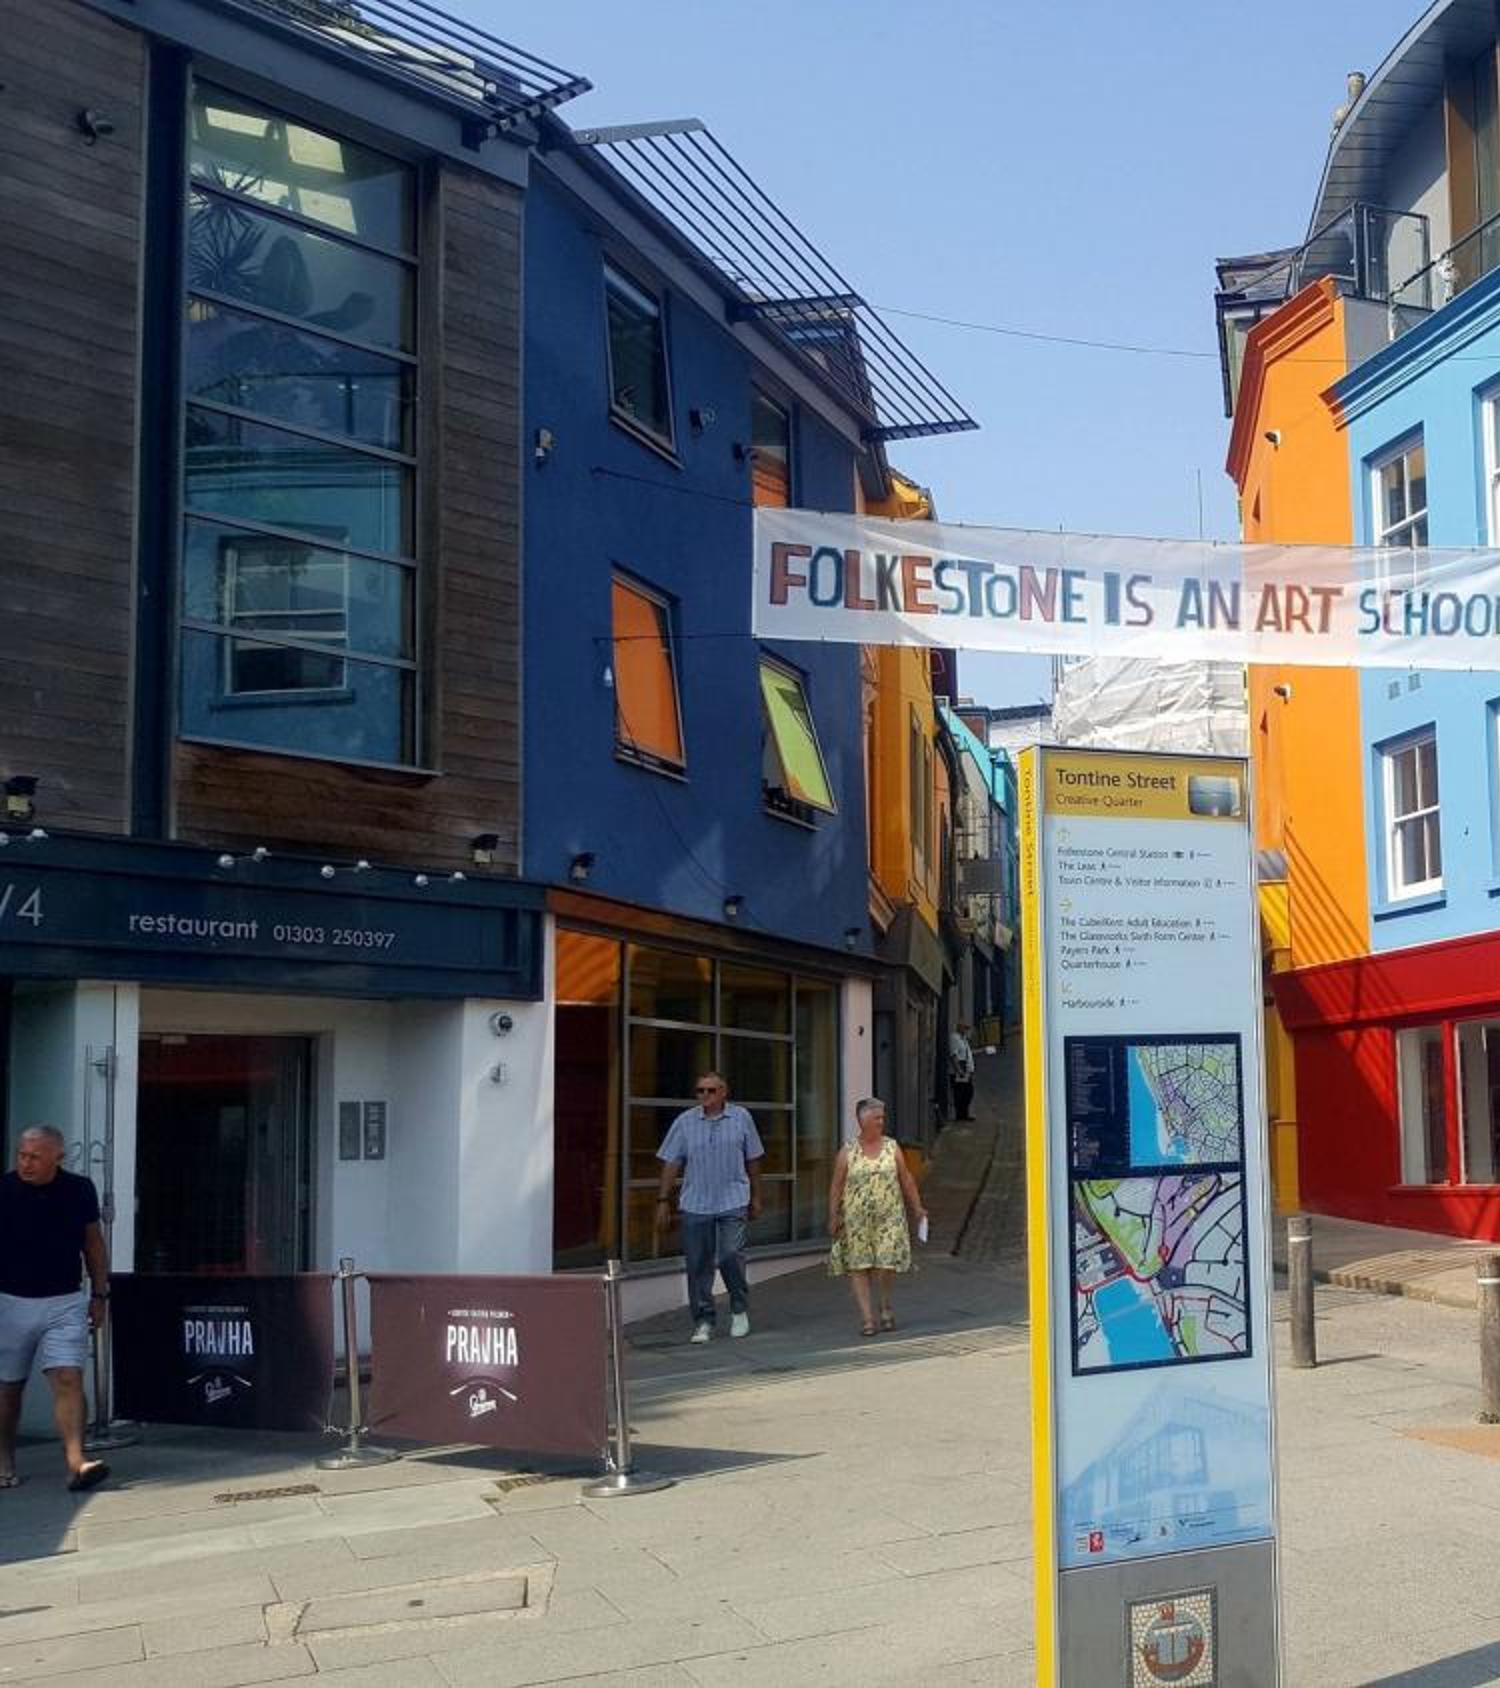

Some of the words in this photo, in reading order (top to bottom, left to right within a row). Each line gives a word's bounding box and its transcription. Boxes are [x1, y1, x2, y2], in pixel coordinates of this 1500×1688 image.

[769, 541, 1087, 624] FOLKESTONE
[1104, 571, 1153, 627] IS
[1175, 577, 1239, 631] AN
[1255, 583, 1344, 635] ART
[1056, 768, 1120, 787] Tontine
[1127, 771, 1176, 789] Street
[1056, 793, 1098, 806] Creative
[1103, 795, 1143, 807] Quarter
[1059, 862, 1074, 870] The
[129, 914, 259, 939] restaurant
[273, 925, 325, 943] 01303
[332, 929, 396, 949] 250397
[1061, 917, 1075, 926] The
[1061, 932, 1076, 940] The
[184, 1320, 254, 1355] PRAVHA
[447, 1325, 518, 1366] PRAVHA
